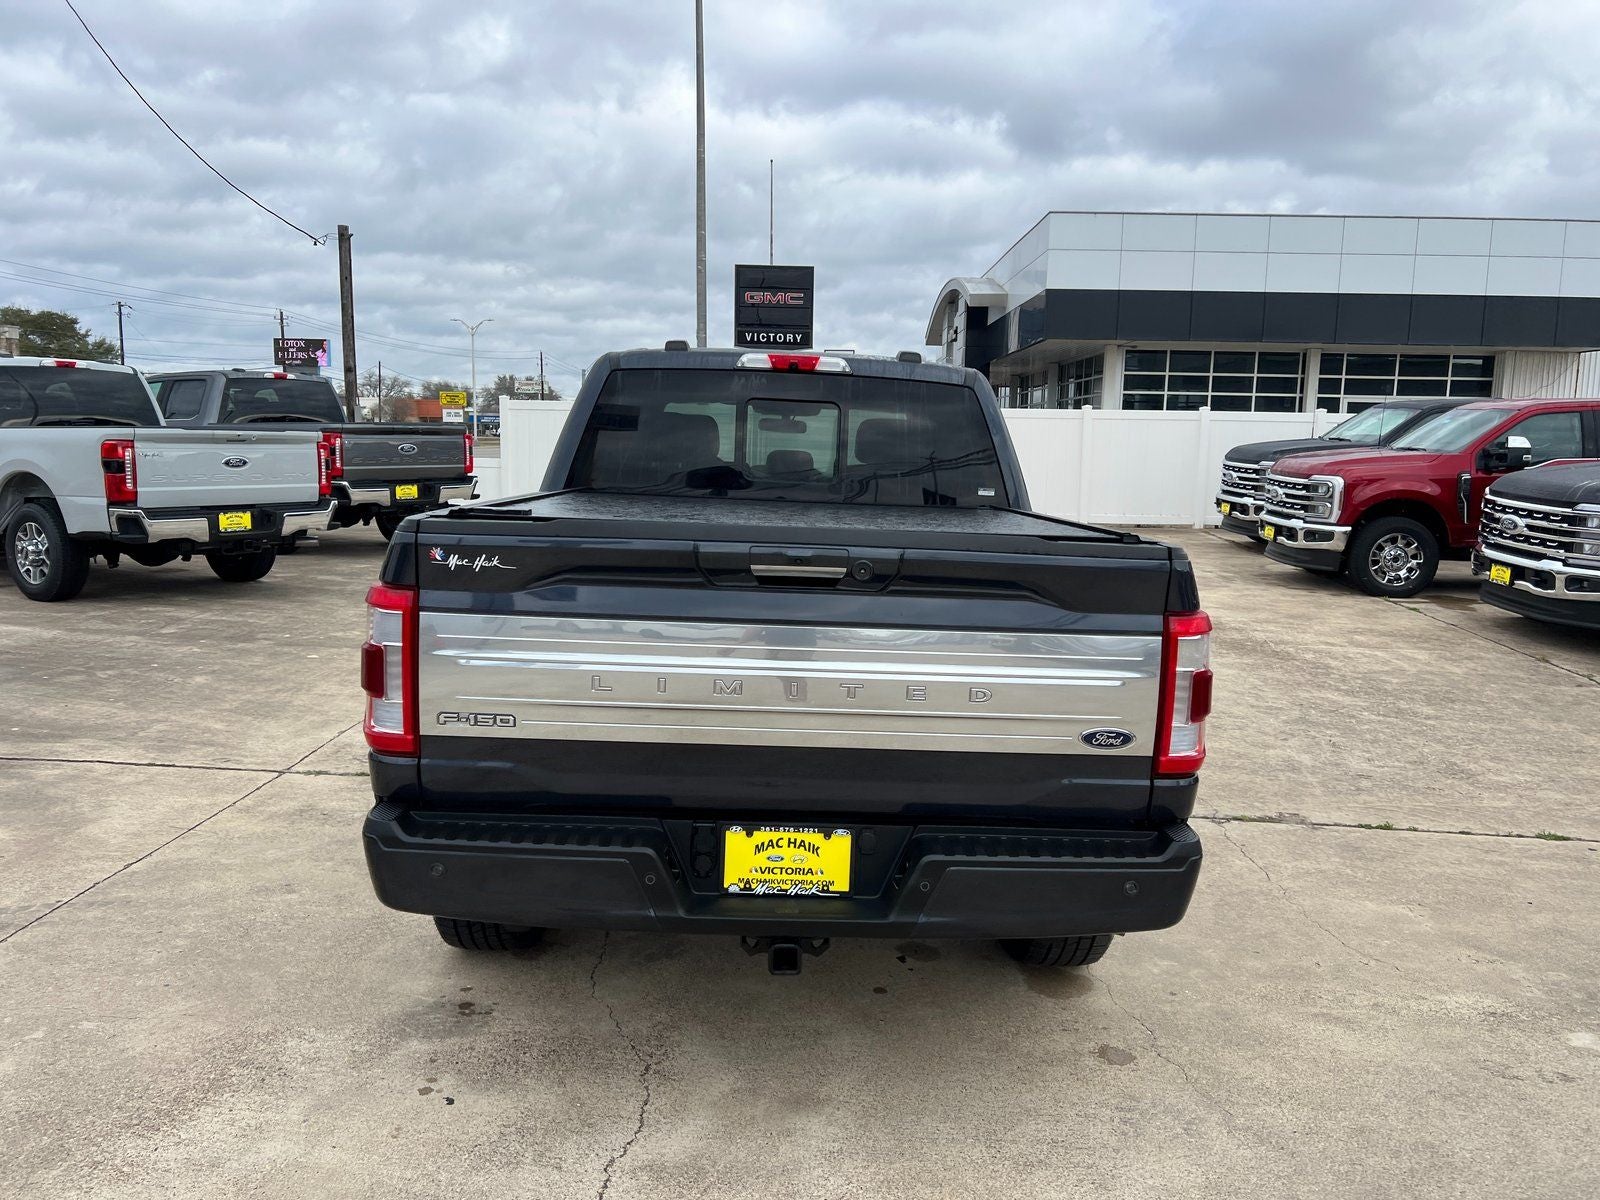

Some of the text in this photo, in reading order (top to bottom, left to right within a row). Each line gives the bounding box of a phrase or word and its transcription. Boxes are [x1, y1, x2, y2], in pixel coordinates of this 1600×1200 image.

[744, 291, 804, 305] GMC
[745, 332, 803, 343] VICTORY
[227, 458, 245, 467] Ford
[151, 471, 313, 484] SUPER DUTY
[437, 553, 514, 572] Mac Haik
[590, 674, 994, 704] LIMITED
[435, 710, 517, 728] F-150
[1090, 730, 1124, 748] Ford
[754, 837, 822, 857] MAC HAIK
[759, 866, 815, 876] VICTORIA
[737, 877, 835, 888] MACHAIKVICTORIA.COM
[751, 882, 828, 897] Mac Haik
